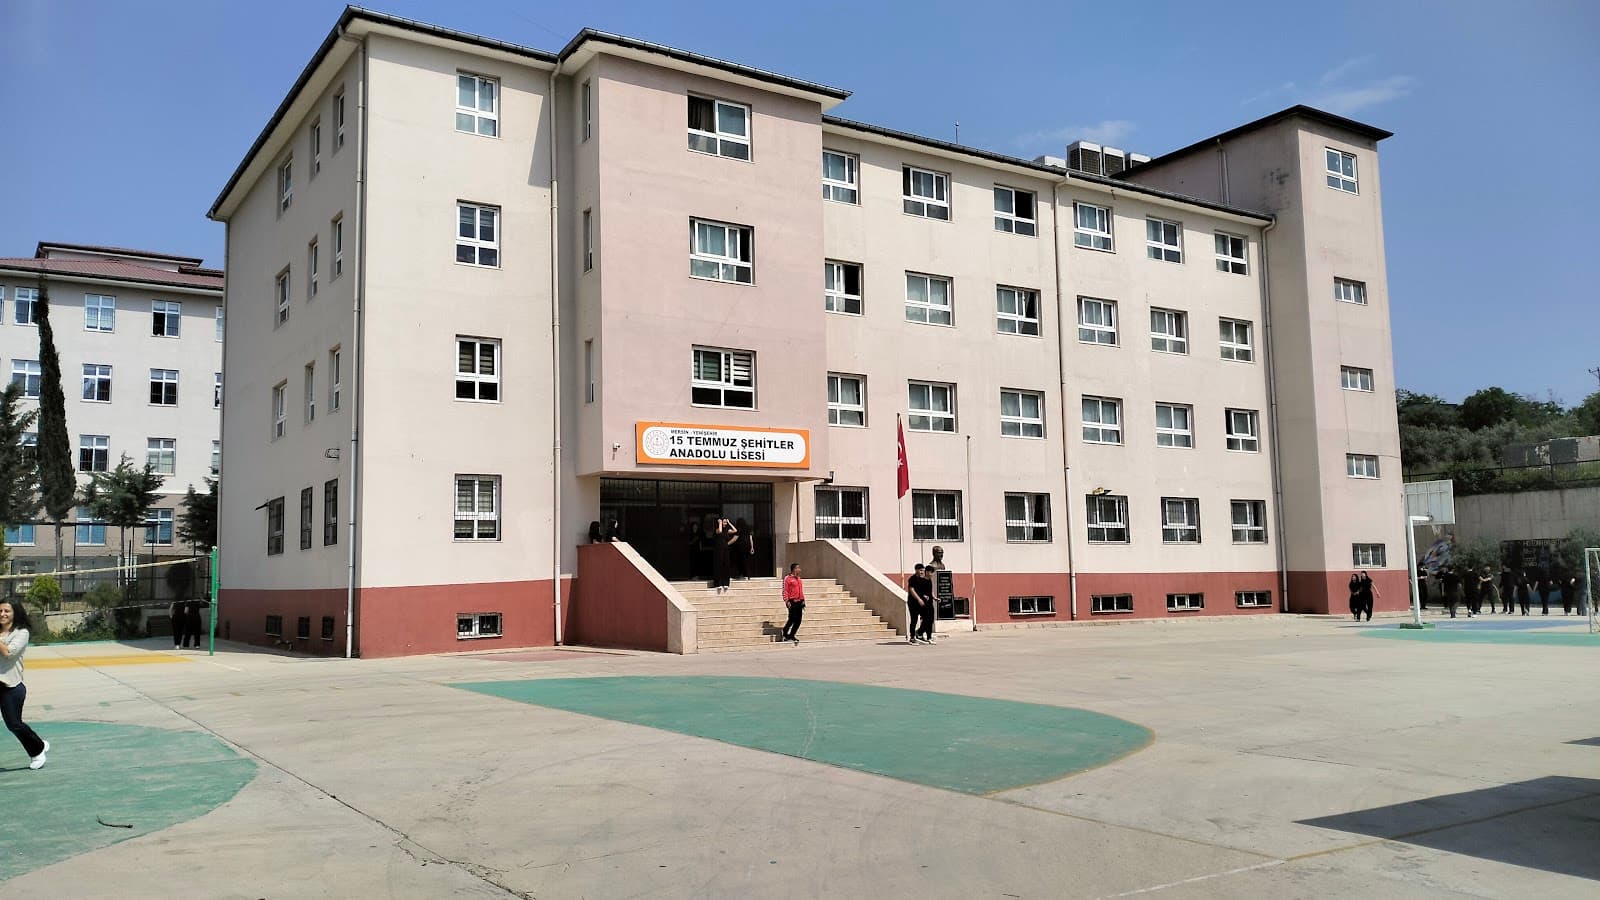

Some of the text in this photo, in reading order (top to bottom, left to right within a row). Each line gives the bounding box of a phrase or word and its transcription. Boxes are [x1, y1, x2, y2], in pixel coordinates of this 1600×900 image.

[669, 435, 794, 449] 15 TEMMUZ ŞEHİTLER
[669, 449, 765, 461] ANADOLU LİSESİ
